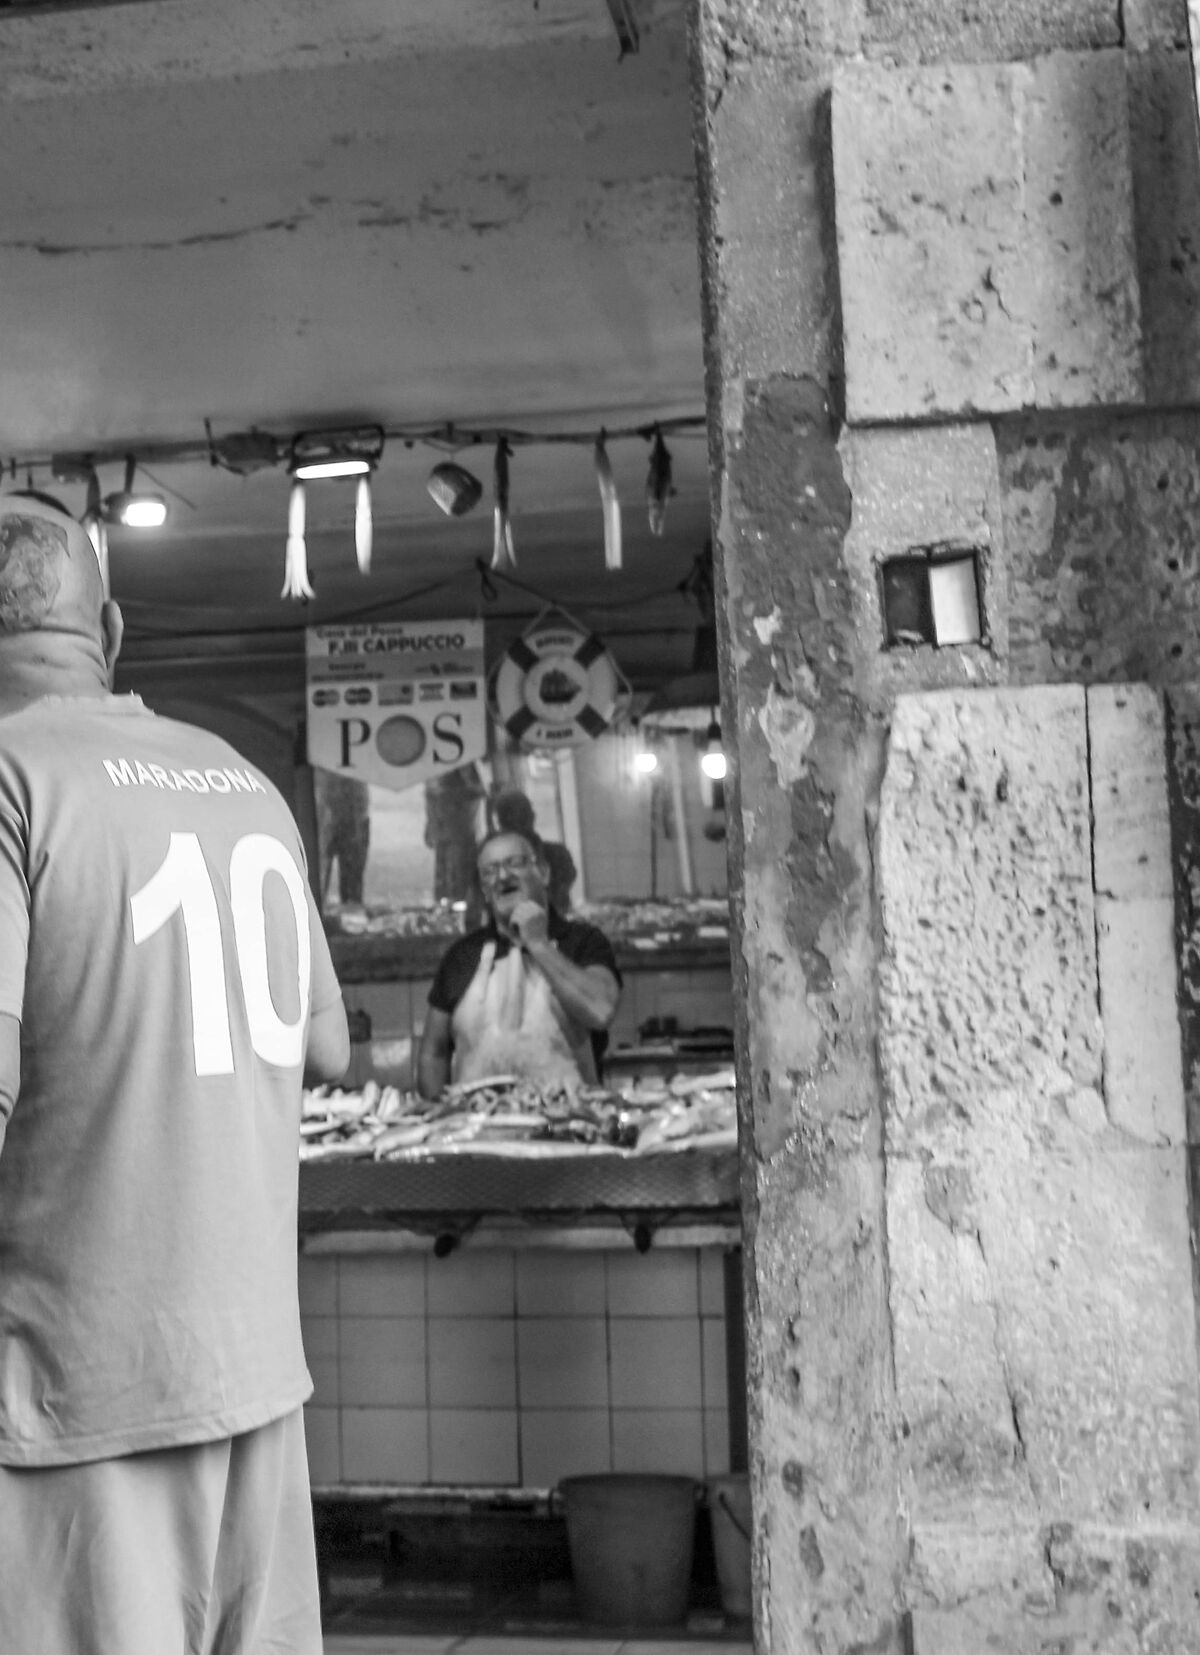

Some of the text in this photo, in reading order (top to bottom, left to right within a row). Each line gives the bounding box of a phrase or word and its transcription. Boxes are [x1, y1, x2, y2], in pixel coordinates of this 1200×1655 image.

[363, 633, 466, 653] CAPPUCCIO
[102, 757, 268, 795] MARADONA
[129, 831, 312, 1077] 10
